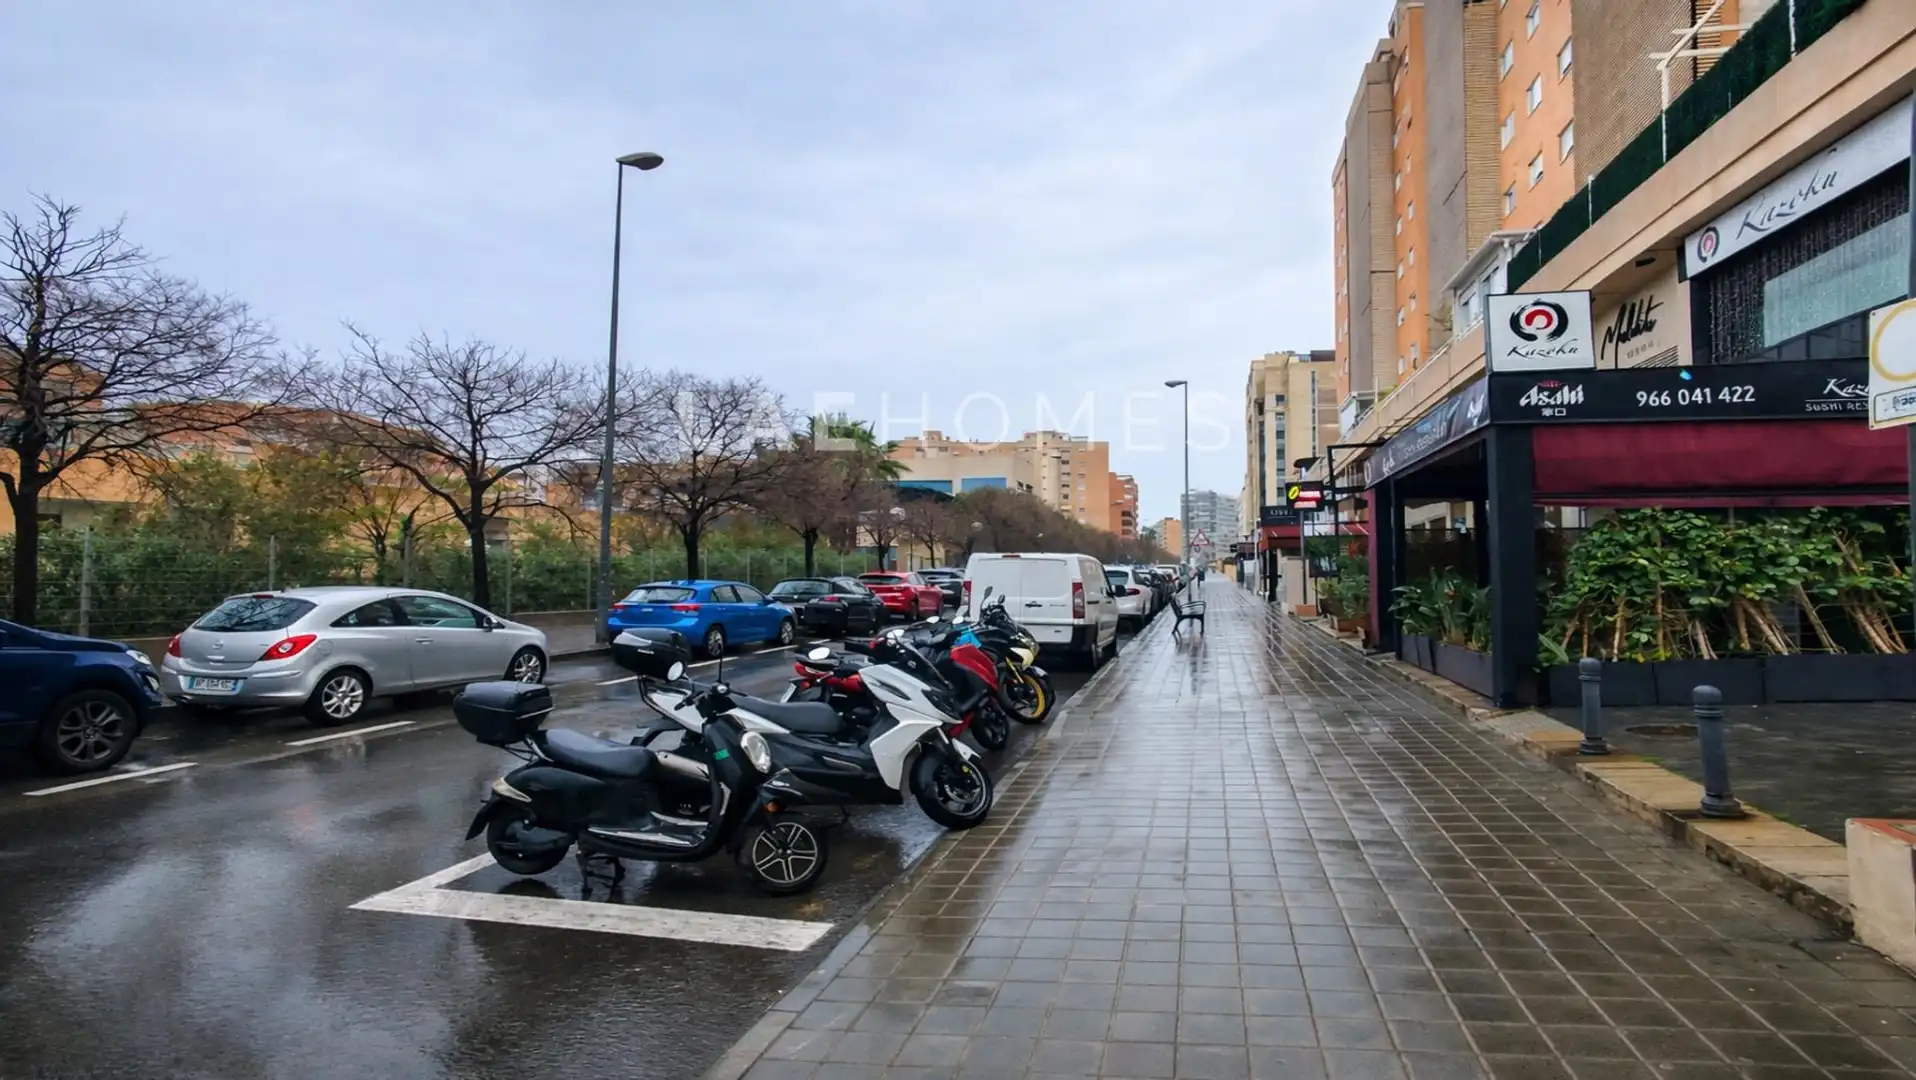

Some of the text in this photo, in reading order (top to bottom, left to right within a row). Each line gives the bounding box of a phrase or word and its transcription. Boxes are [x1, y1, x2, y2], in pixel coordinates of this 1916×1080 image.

[1507, 338, 1577, 358] Kazoku
[1519, 384, 1584, 407] Asahi
[1636, 385, 1755, 407] 966 041 422
